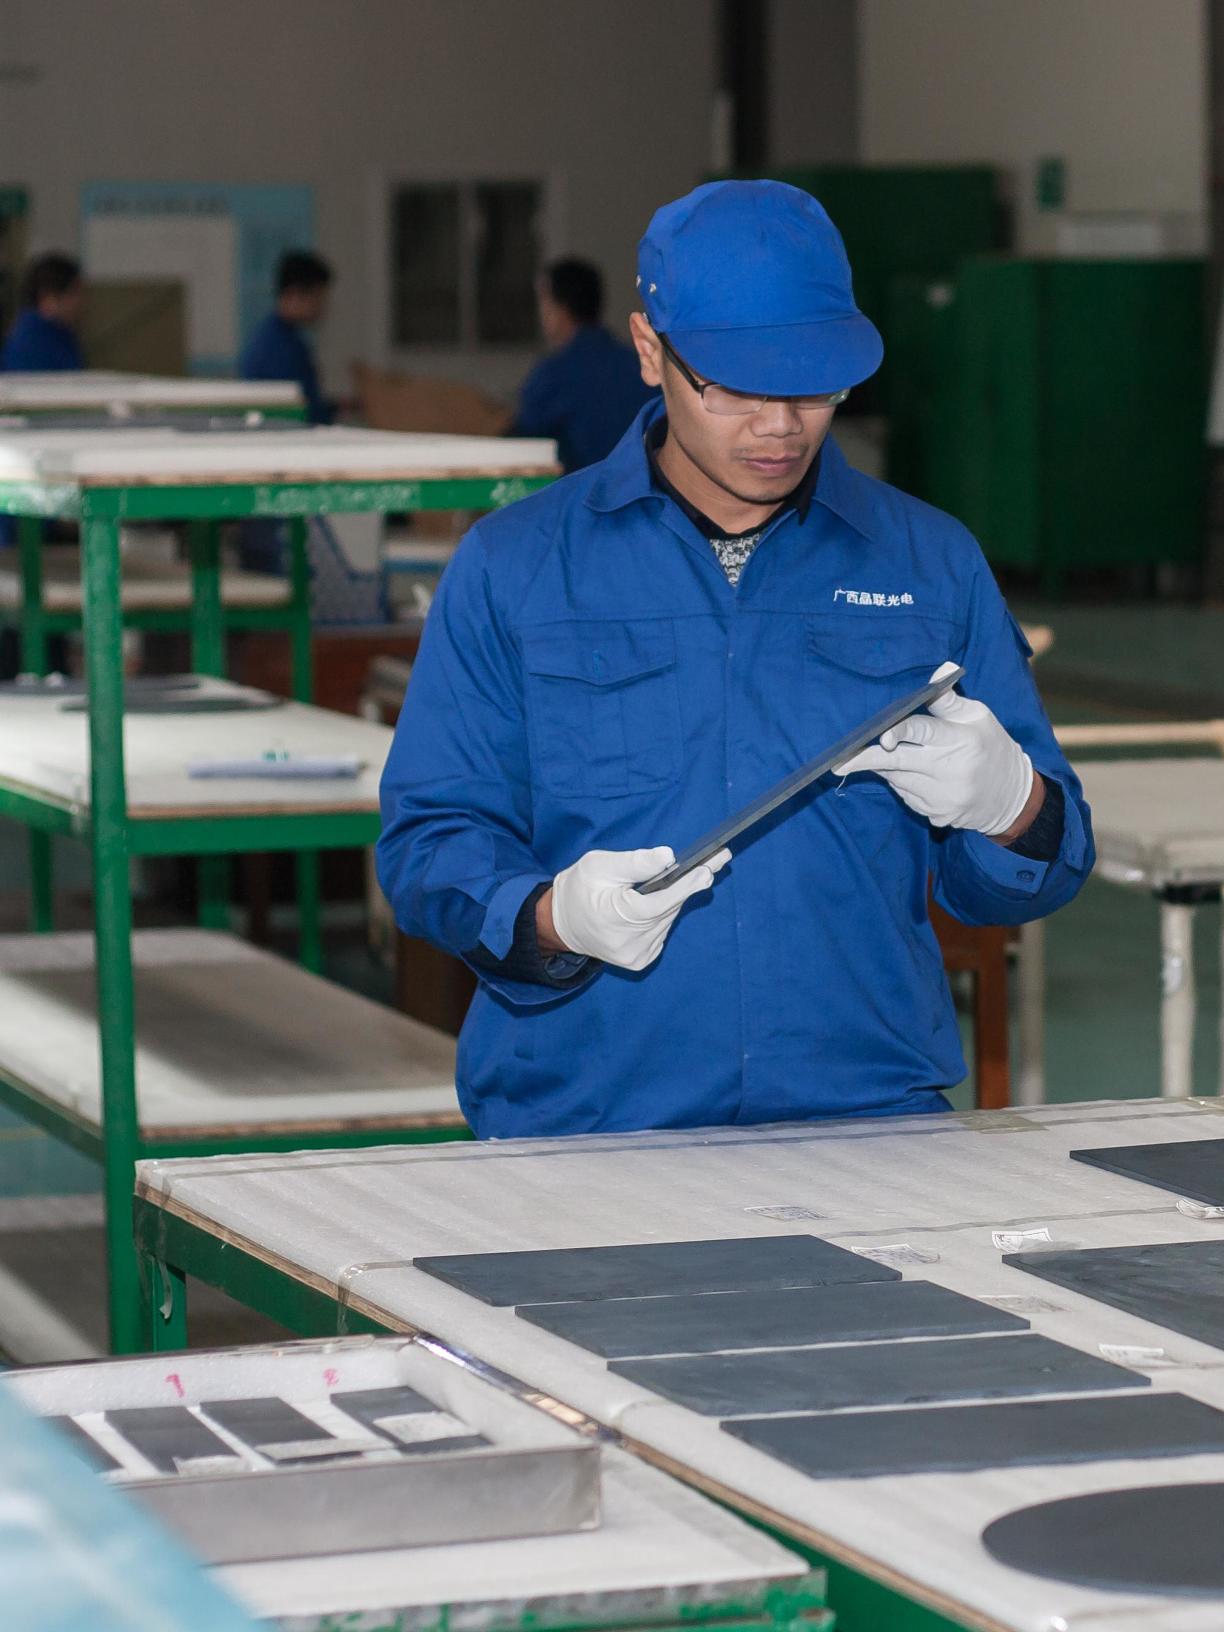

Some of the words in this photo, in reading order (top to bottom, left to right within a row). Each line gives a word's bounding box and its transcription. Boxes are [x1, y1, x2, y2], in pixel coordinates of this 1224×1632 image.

[832, 588, 914, 607] 广西晶联光电
